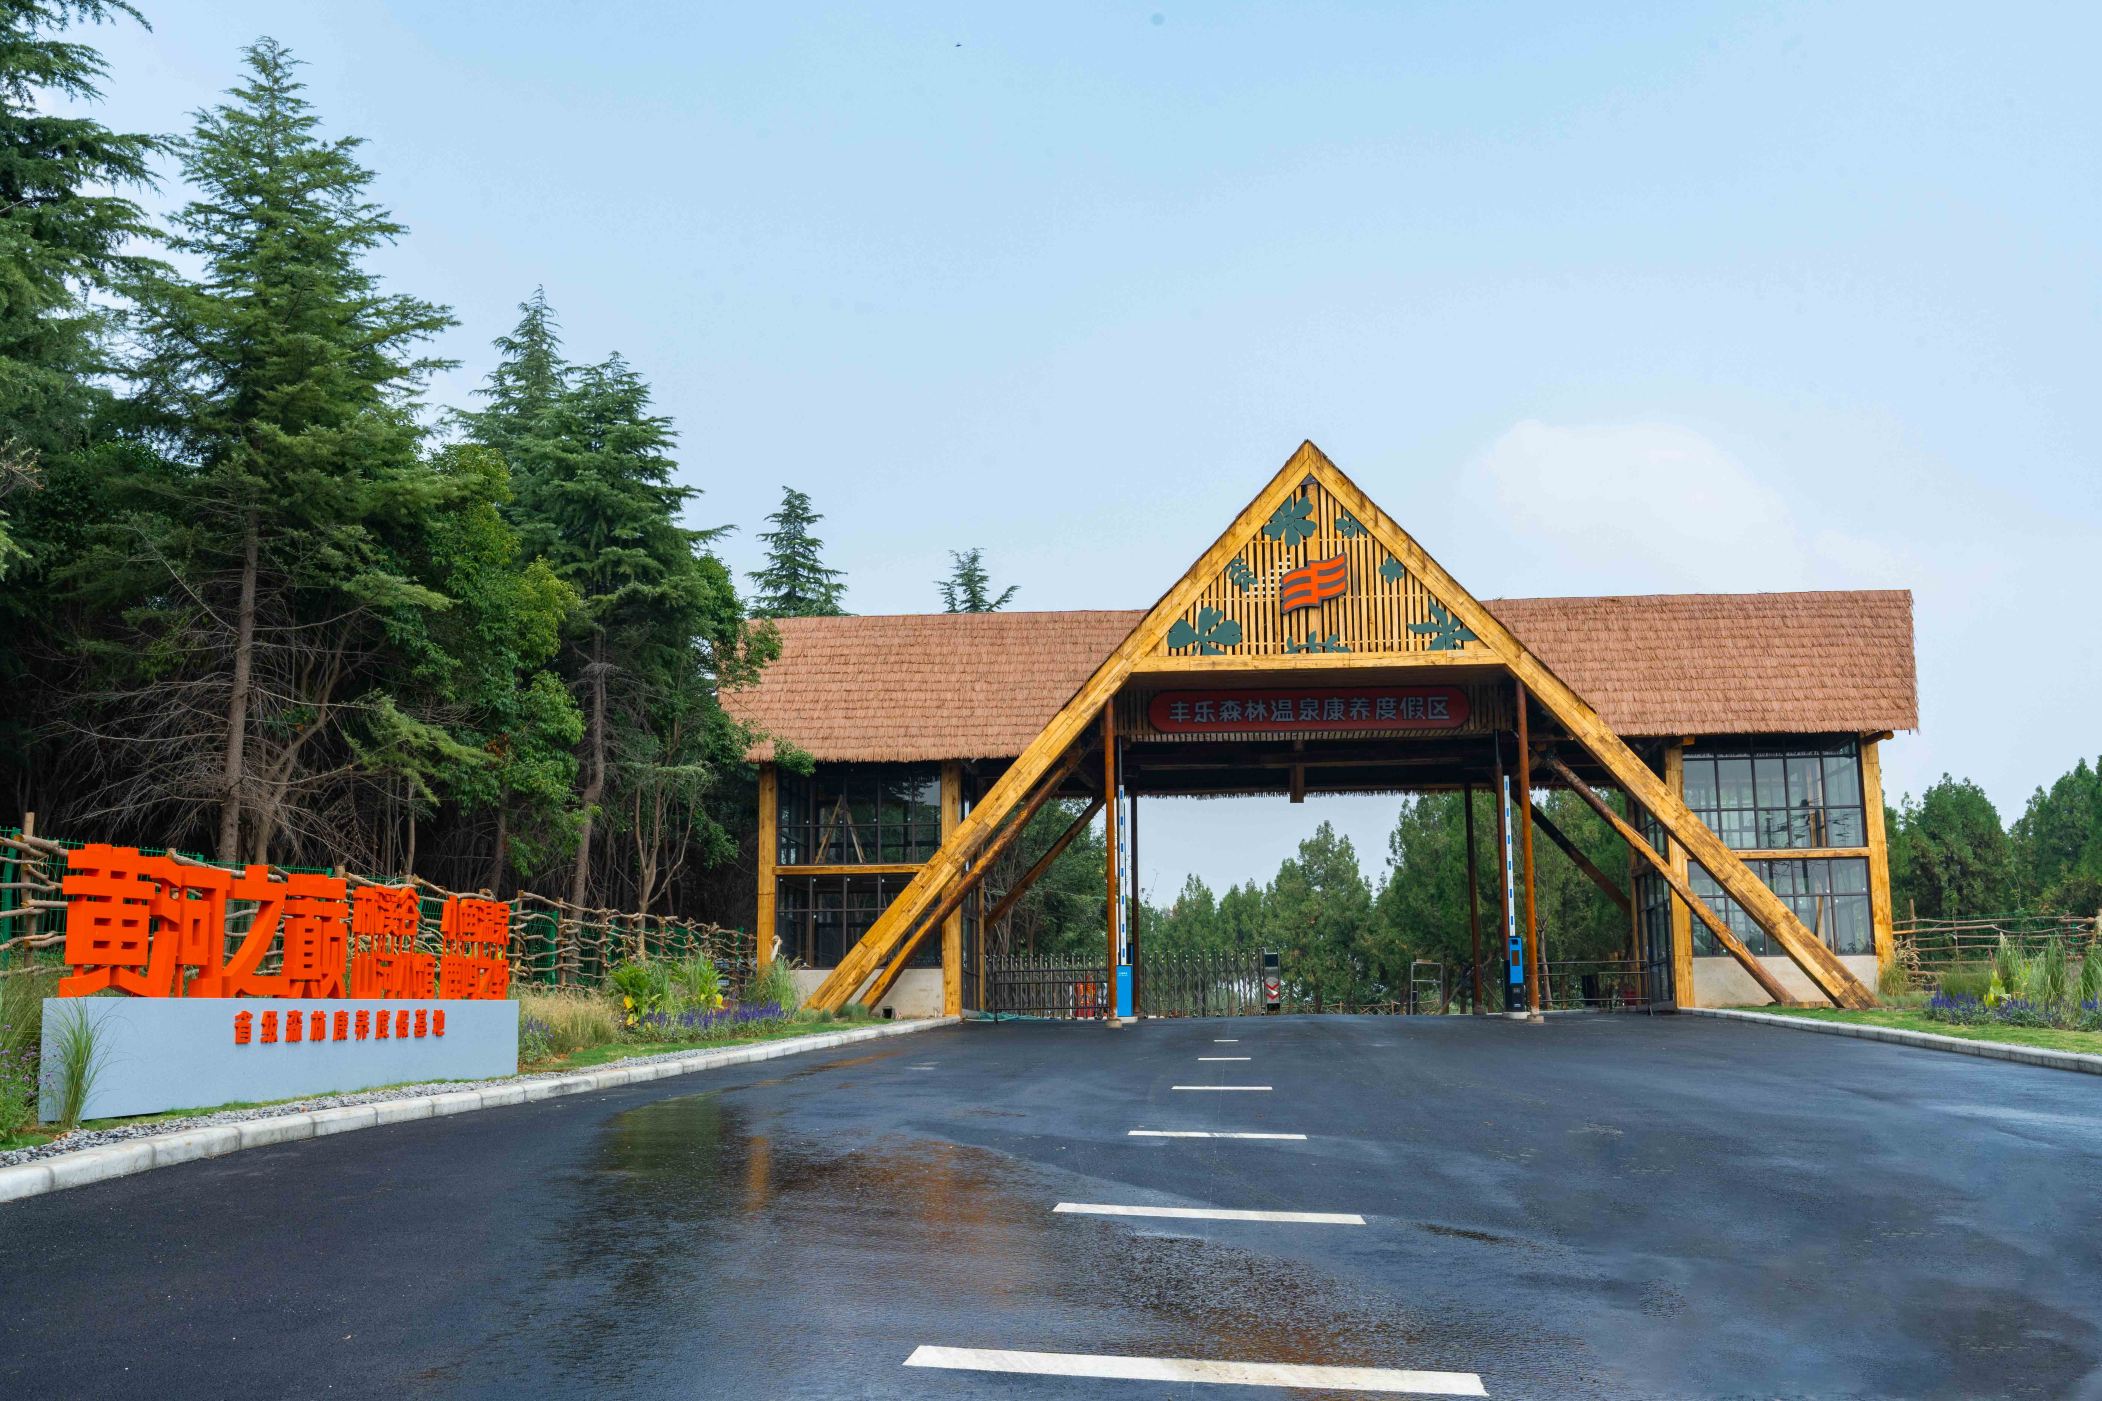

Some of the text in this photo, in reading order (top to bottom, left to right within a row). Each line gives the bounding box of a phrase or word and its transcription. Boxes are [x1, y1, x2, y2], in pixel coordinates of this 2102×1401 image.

[1168, 696, 1451, 723] 丰乐森林温泉康养度假区
[234, 1008, 446, 1044] 省级森林康养度假基地
